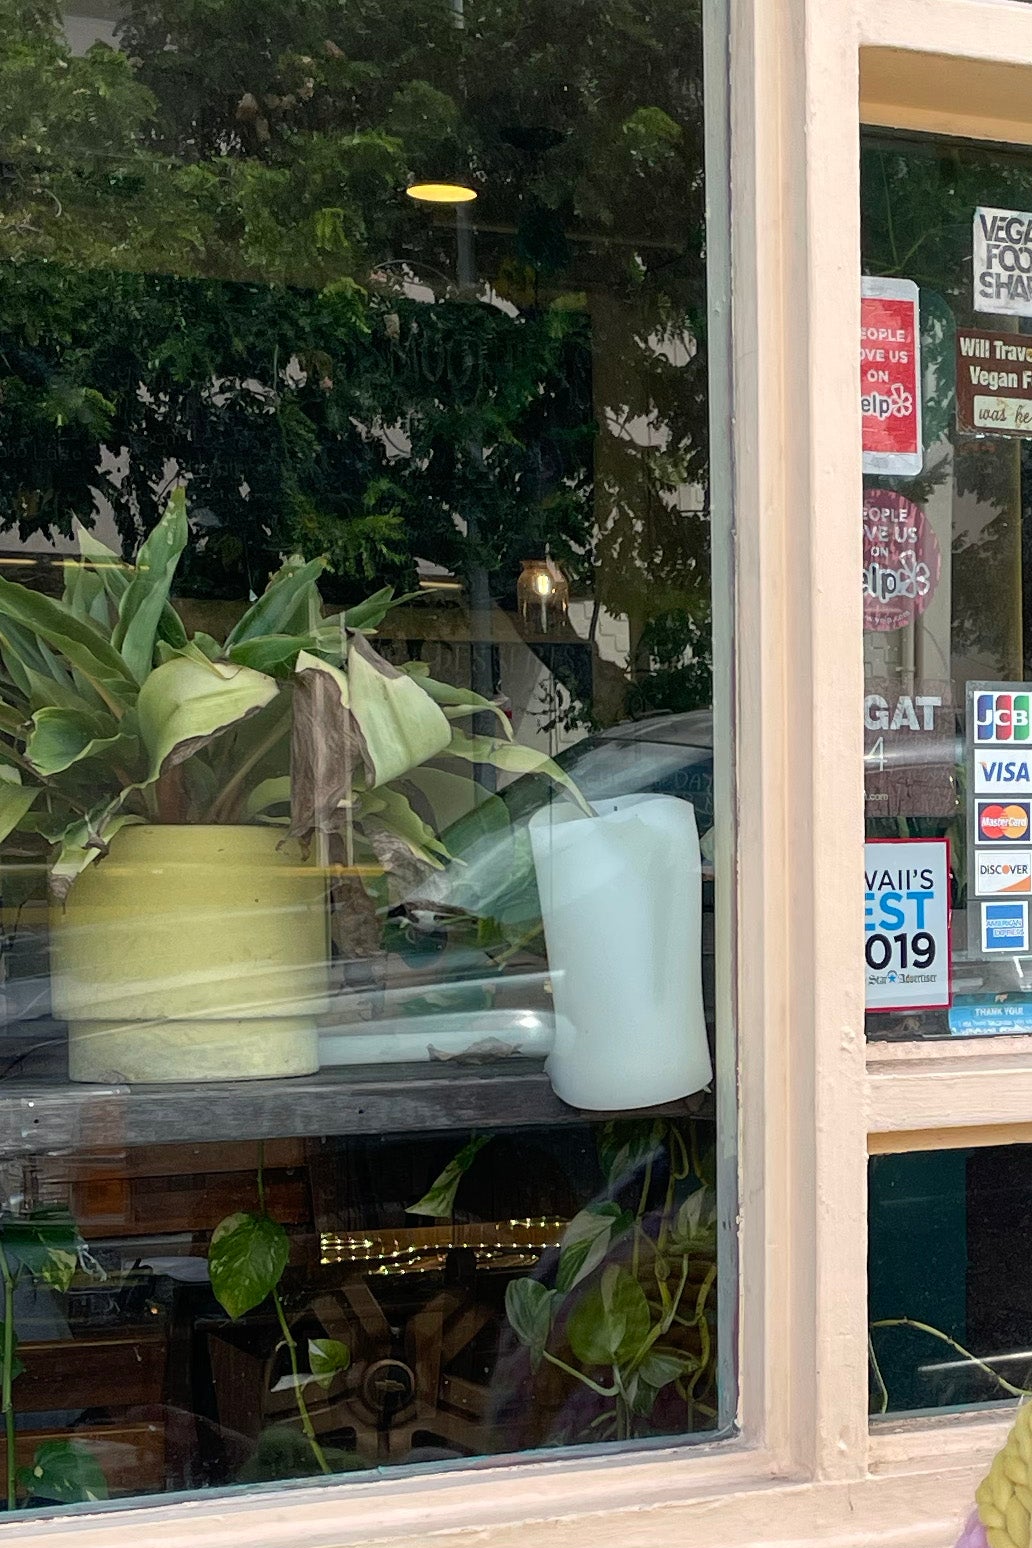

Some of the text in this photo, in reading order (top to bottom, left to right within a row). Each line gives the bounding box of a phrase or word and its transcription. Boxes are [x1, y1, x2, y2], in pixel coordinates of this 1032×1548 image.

[959, 336, 990, 359] Will
[889, 350, 908, 364] US
[867, 370, 889, 382] ON
[969, 365, 1018, 391] Vegan
[978, 408, 1007, 422] was
[895, 527, 918, 544] US
[870, 546, 889, 558] ON
[976, 709, 1029, 727] JCB
[864, 736, 887, 771] 4
[979, 761, 1030, 782] VISA
[981, 816, 1028, 827] MasterCard
